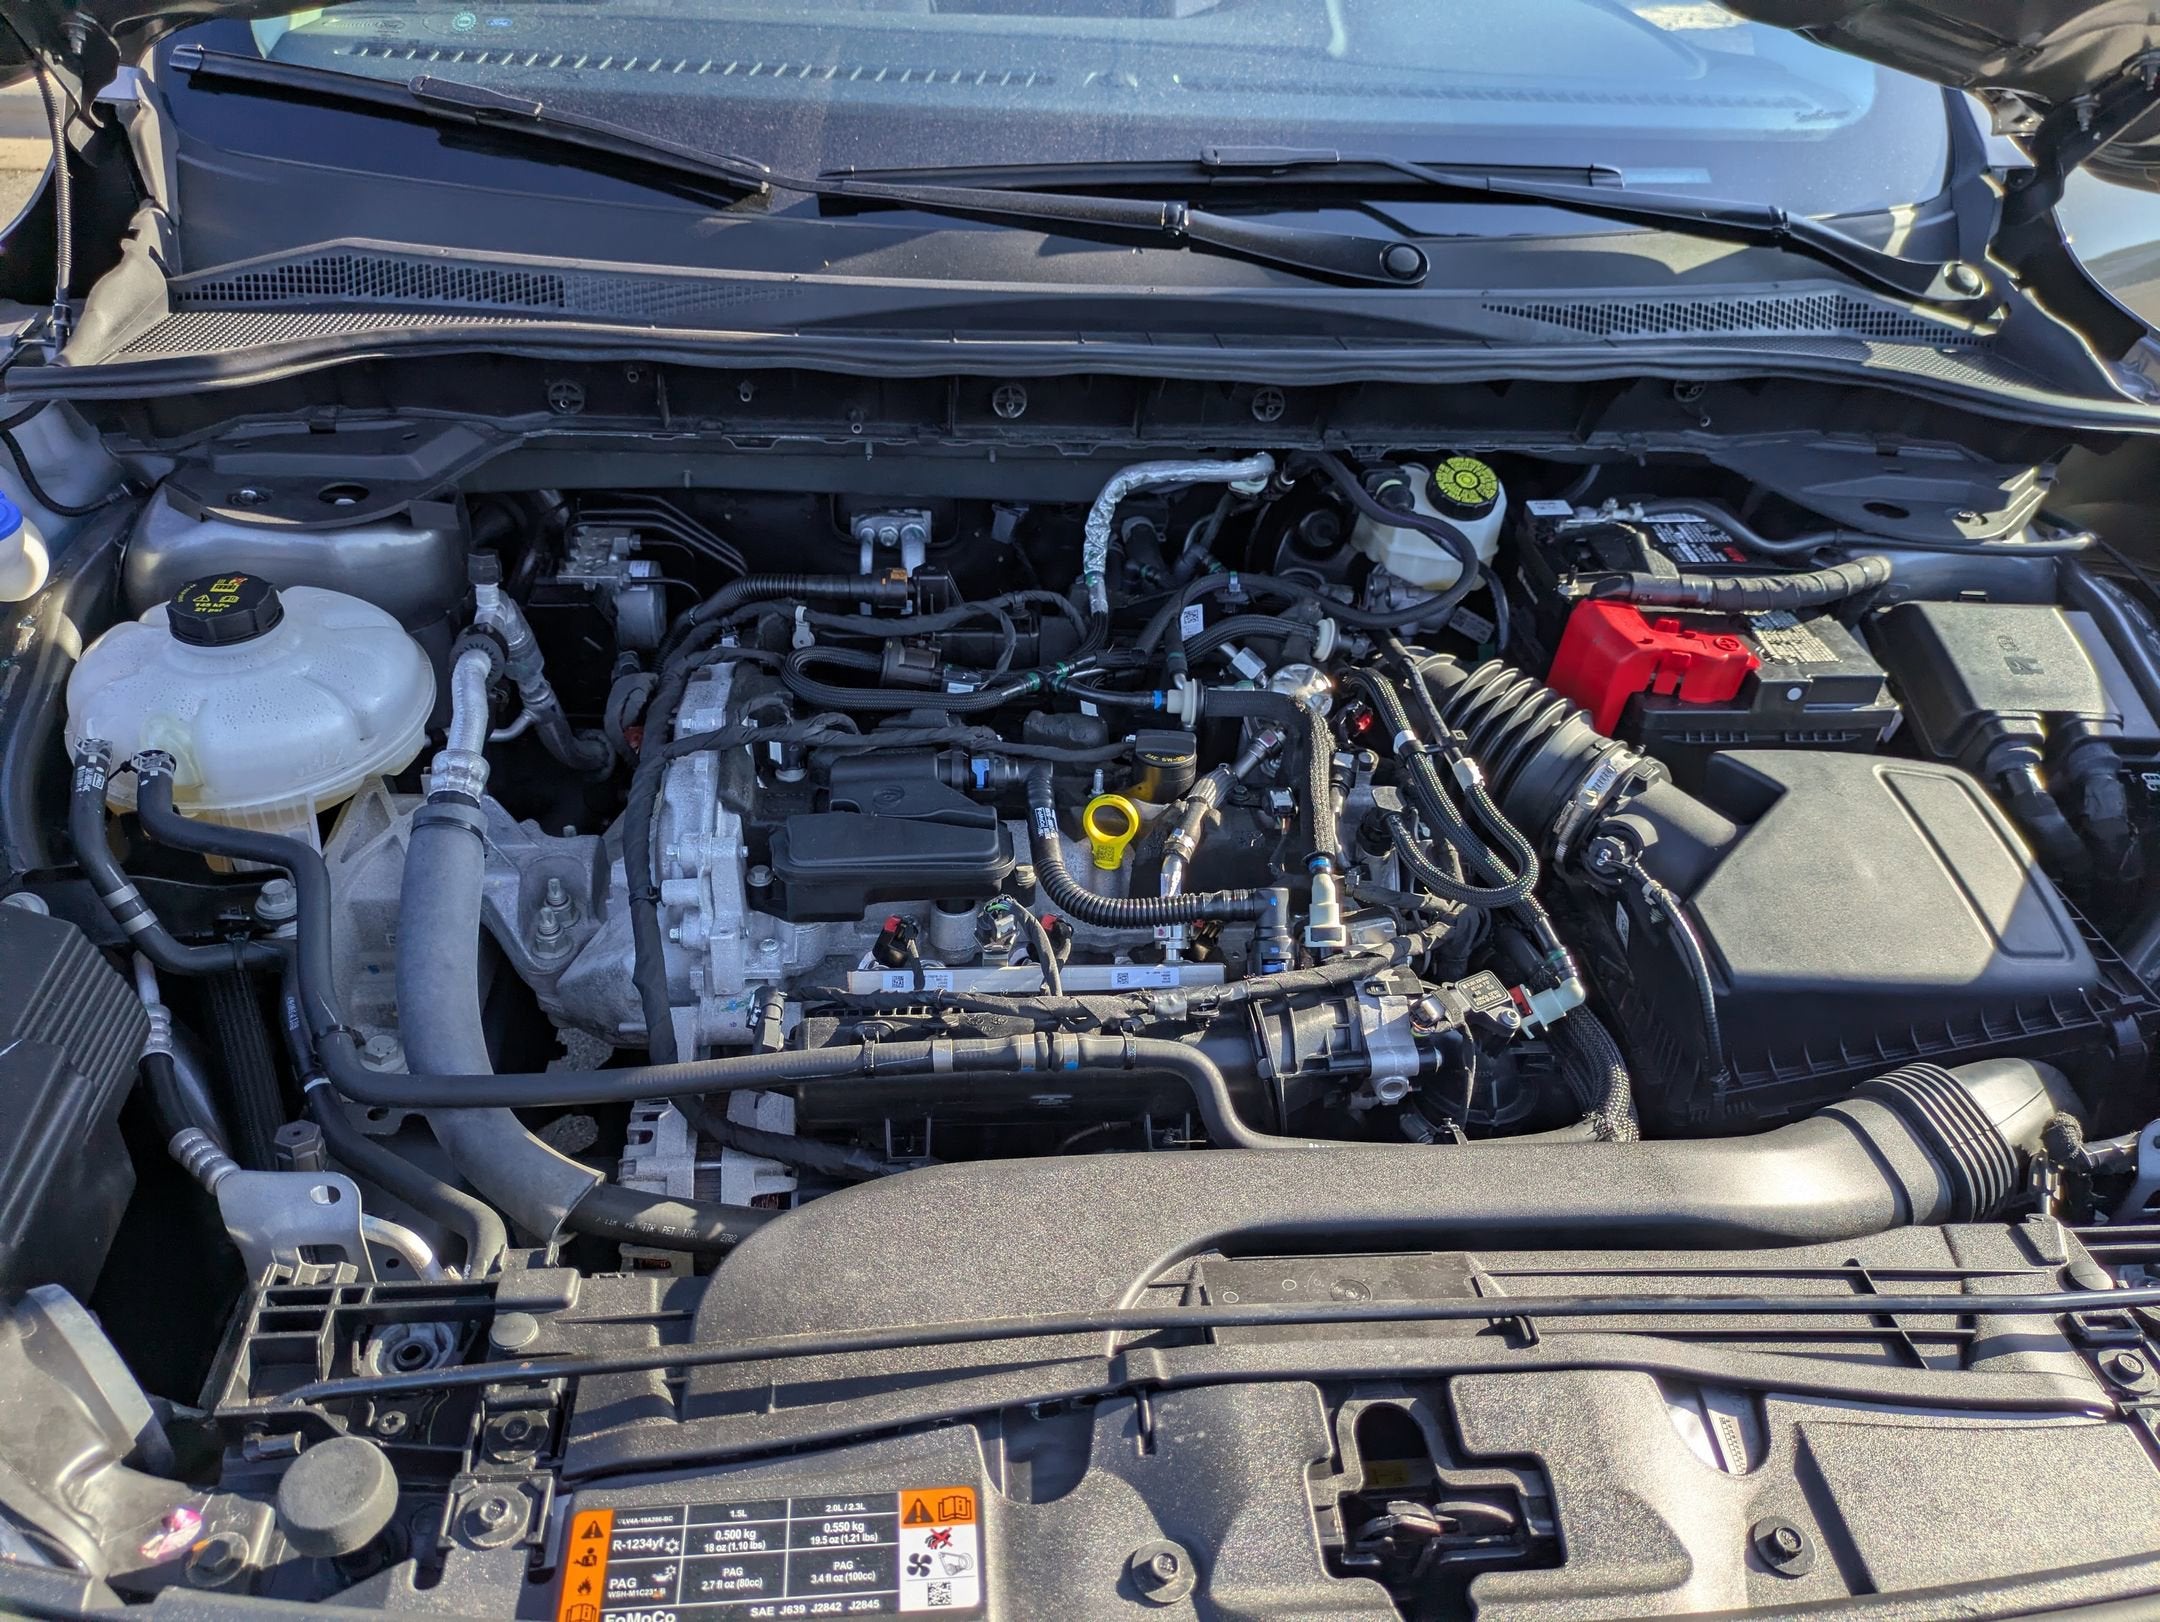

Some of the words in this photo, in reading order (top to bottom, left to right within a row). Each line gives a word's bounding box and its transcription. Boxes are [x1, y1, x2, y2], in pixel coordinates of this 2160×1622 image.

[729, 1509, 748, 1518] 1.5L
[825, 1504, 843, 1512] 2.0L
[848, 1502, 866, 1511] 2.3L
[823, 1521, 850, 1533] 0.550
[851, 1520, 865, 1533] kg
[714, 1529, 742, 1541] 0.500
[743, 1528, 757, 1540] kg
[810, 1535, 827, 1545] 19.5
[828, 1536, 840, 1544] oz
[841, 1533, 860, 1545] (1.21
[862, 1532, 878, 1543] lbs)
[612, 1537, 664, 1551] R-1234yf
[704, 1543, 714, 1552] 18
[716, 1544, 726, 1552] oz
[728, 1541, 749, 1552] (1.10
[750, 1540, 766, 1551] lbs)
[722, 1567, 744, 1577] PAG
[833, 1560, 854, 1571] PAG
[608, 1577, 638, 1590] PAG
[701, 1580, 715, 1590] 2.7
[717, 1579, 723, 1589] fl
[724, 1580, 735, 1589] oz
[736, 1577, 763, 1589] (80cc)
[810, 1574, 824, 1584] 3.4
[825, 1573, 832, 1583] fl
[832, 1574, 844, 1583] oz
[845, 1570, 876, 1583] (100cc)
[750, 1606, 775, 1617] SAE
[779, 1604, 806, 1615] J639
[810, 1602, 842, 1613] J2842
[848, 1599, 880, 1611] J2845
